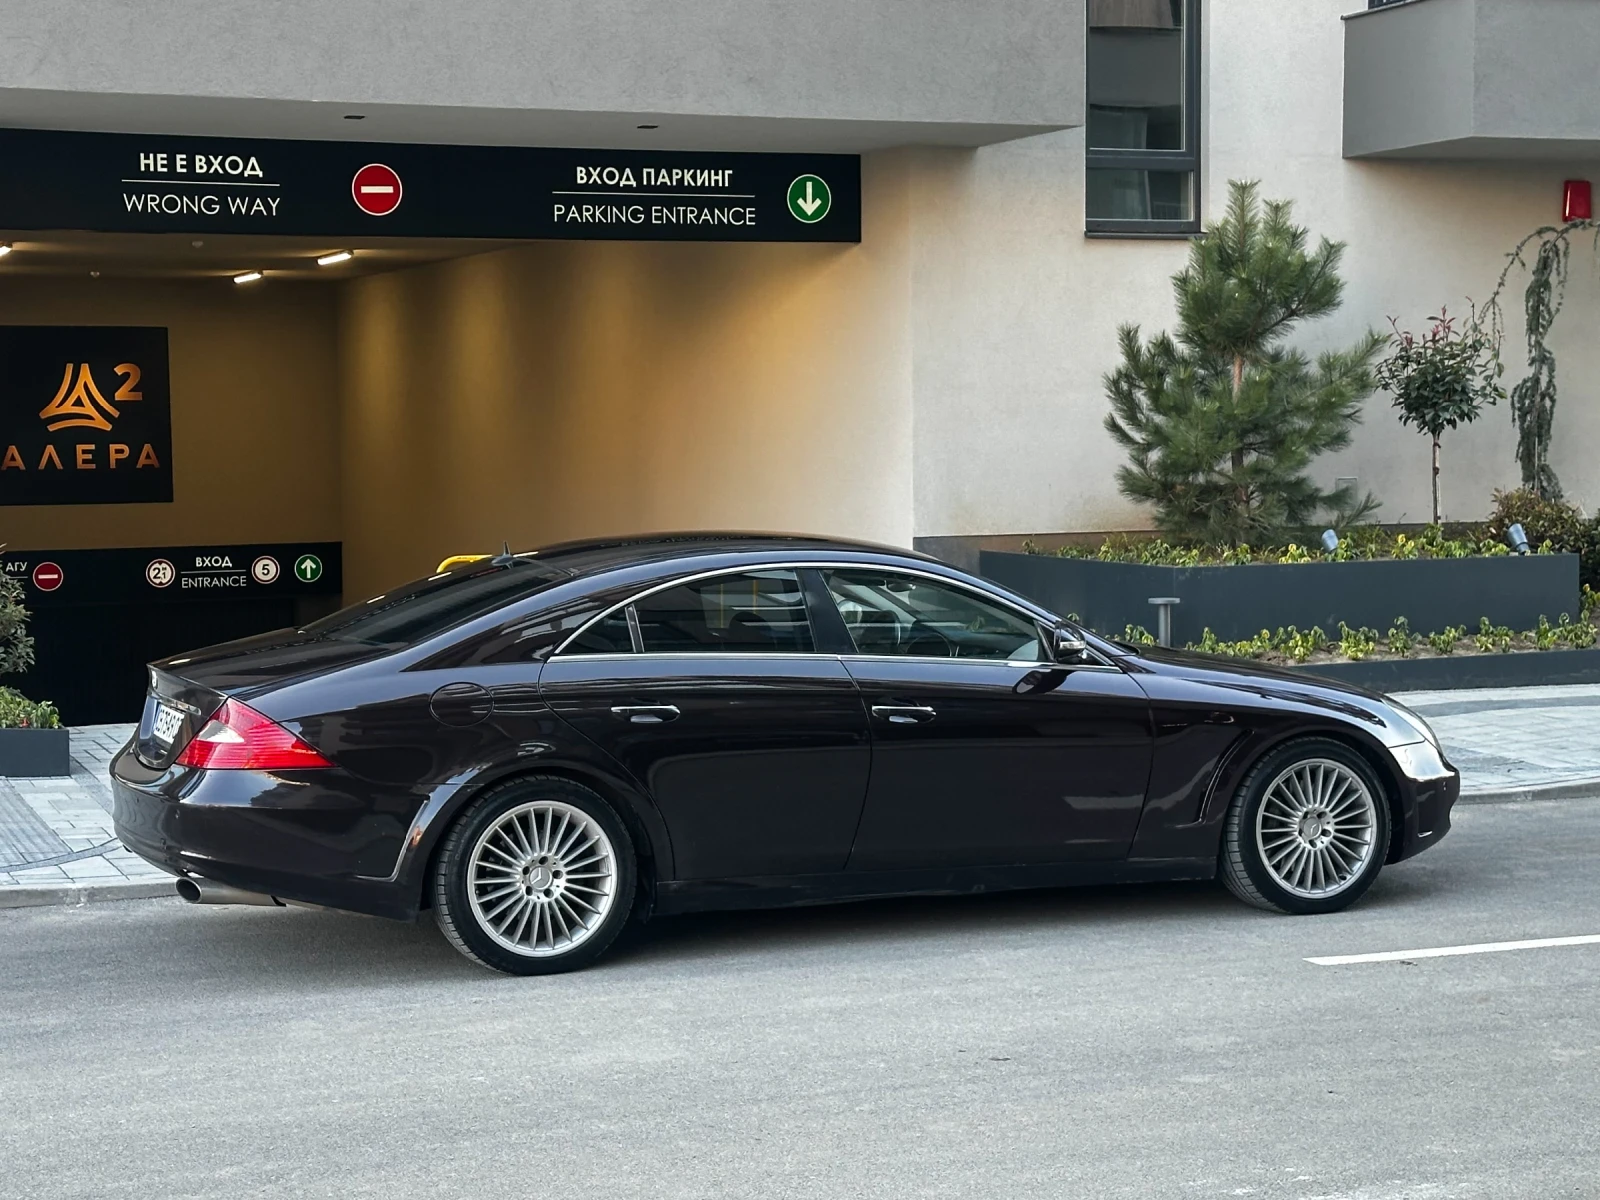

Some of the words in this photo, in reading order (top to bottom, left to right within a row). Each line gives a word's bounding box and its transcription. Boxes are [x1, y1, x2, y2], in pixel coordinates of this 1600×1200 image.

[139, 152, 168, 173] НЕ
[175, 153, 188, 173] Е
[195, 154, 264, 178] ВХОД
[576, 166, 637, 188] ВХОД
[642, 168, 733, 187] ПАРКИНГ
[123, 193, 220, 215] WRONG
[227, 197, 281, 217] WAY
[554, 204, 645, 224] PARKING
[651, 206, 756, 226] ENTRANCE
[113, 363, 143, 401] 2
[195, 556, 233, 568] ВХОД
[261, 563, 270, 576] 5
[181, 575, 247, 589] ENTRANCE
